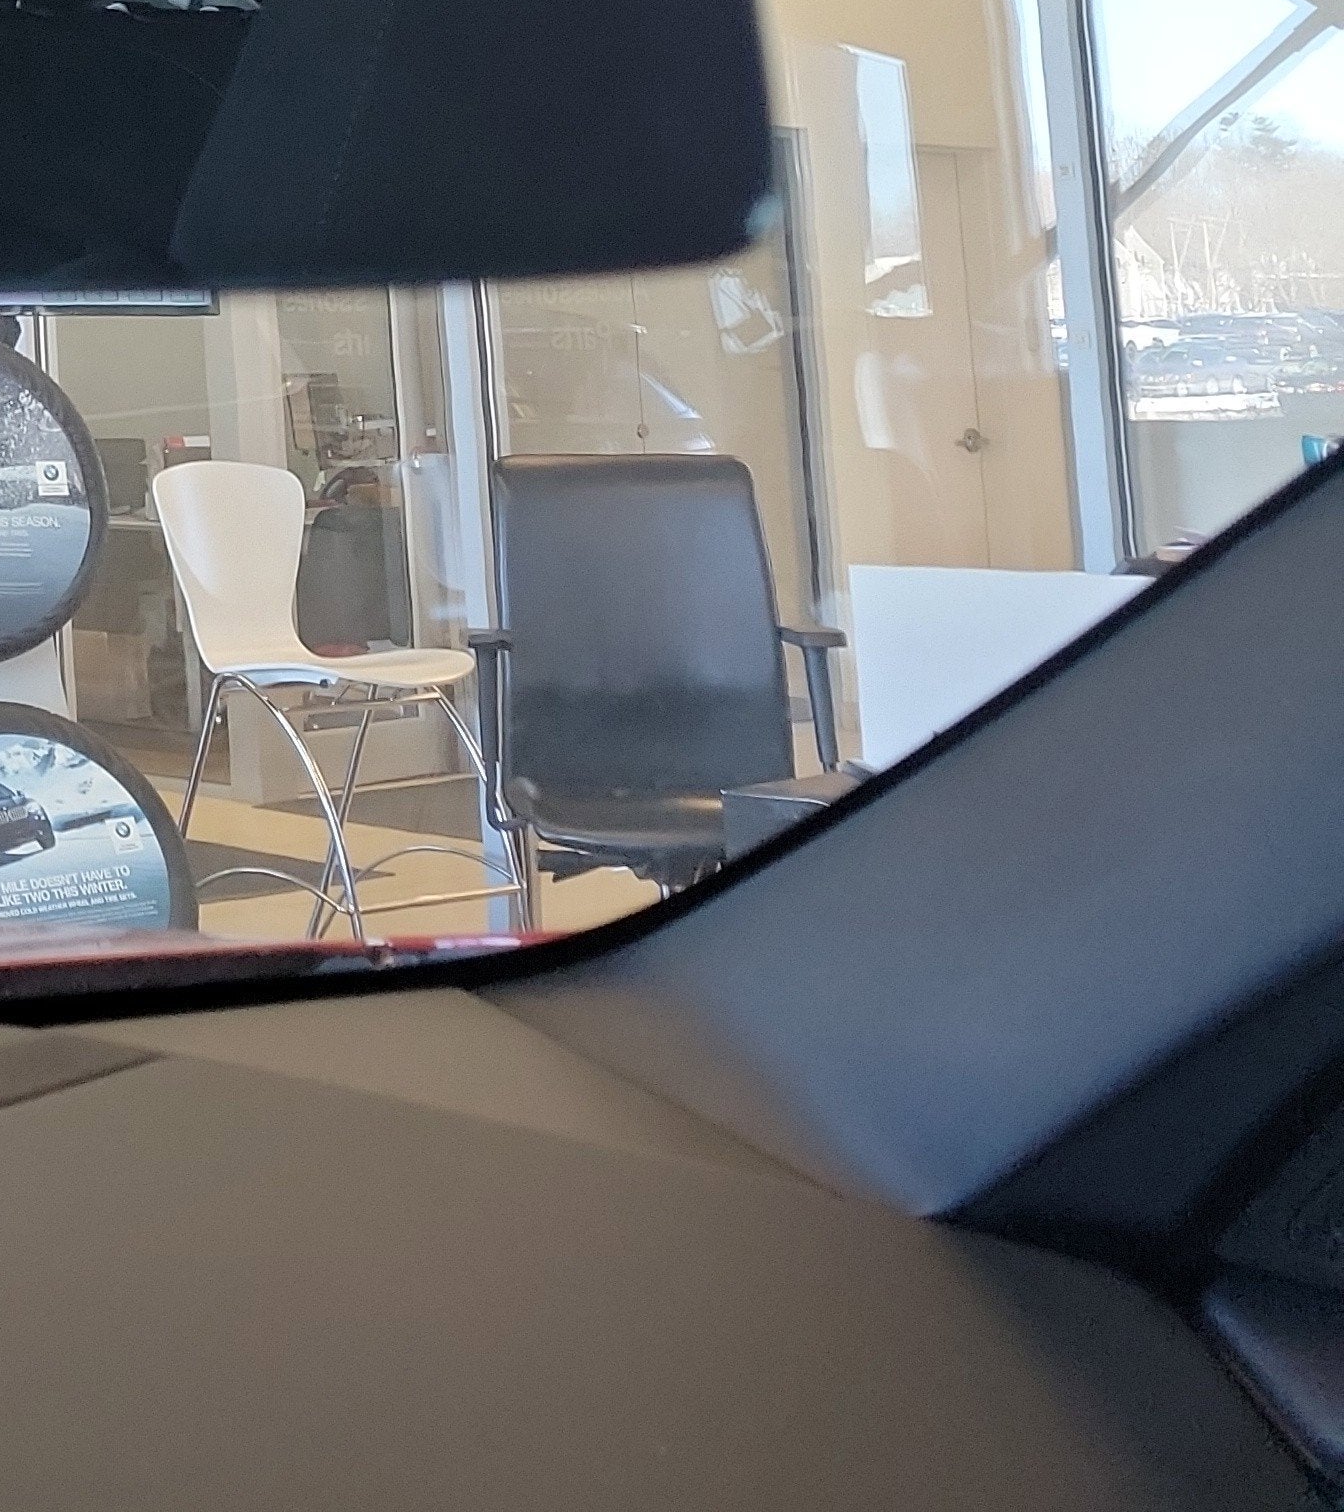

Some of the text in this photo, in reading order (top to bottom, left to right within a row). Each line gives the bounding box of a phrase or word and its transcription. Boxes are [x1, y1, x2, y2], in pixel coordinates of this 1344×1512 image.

[11, 516, 62, 529] SEASON.
[1, 879, 29, 894] MILE
[30, 874, 79, 890] DOESN'T
[80, 870, 112, 885] HAVE
[115, 865, 131, 878] TO
[24, 889, 51, 904] TWO
[53, 885, 79, 901] THIS
[80, 879, 128, 896] WINTER.
